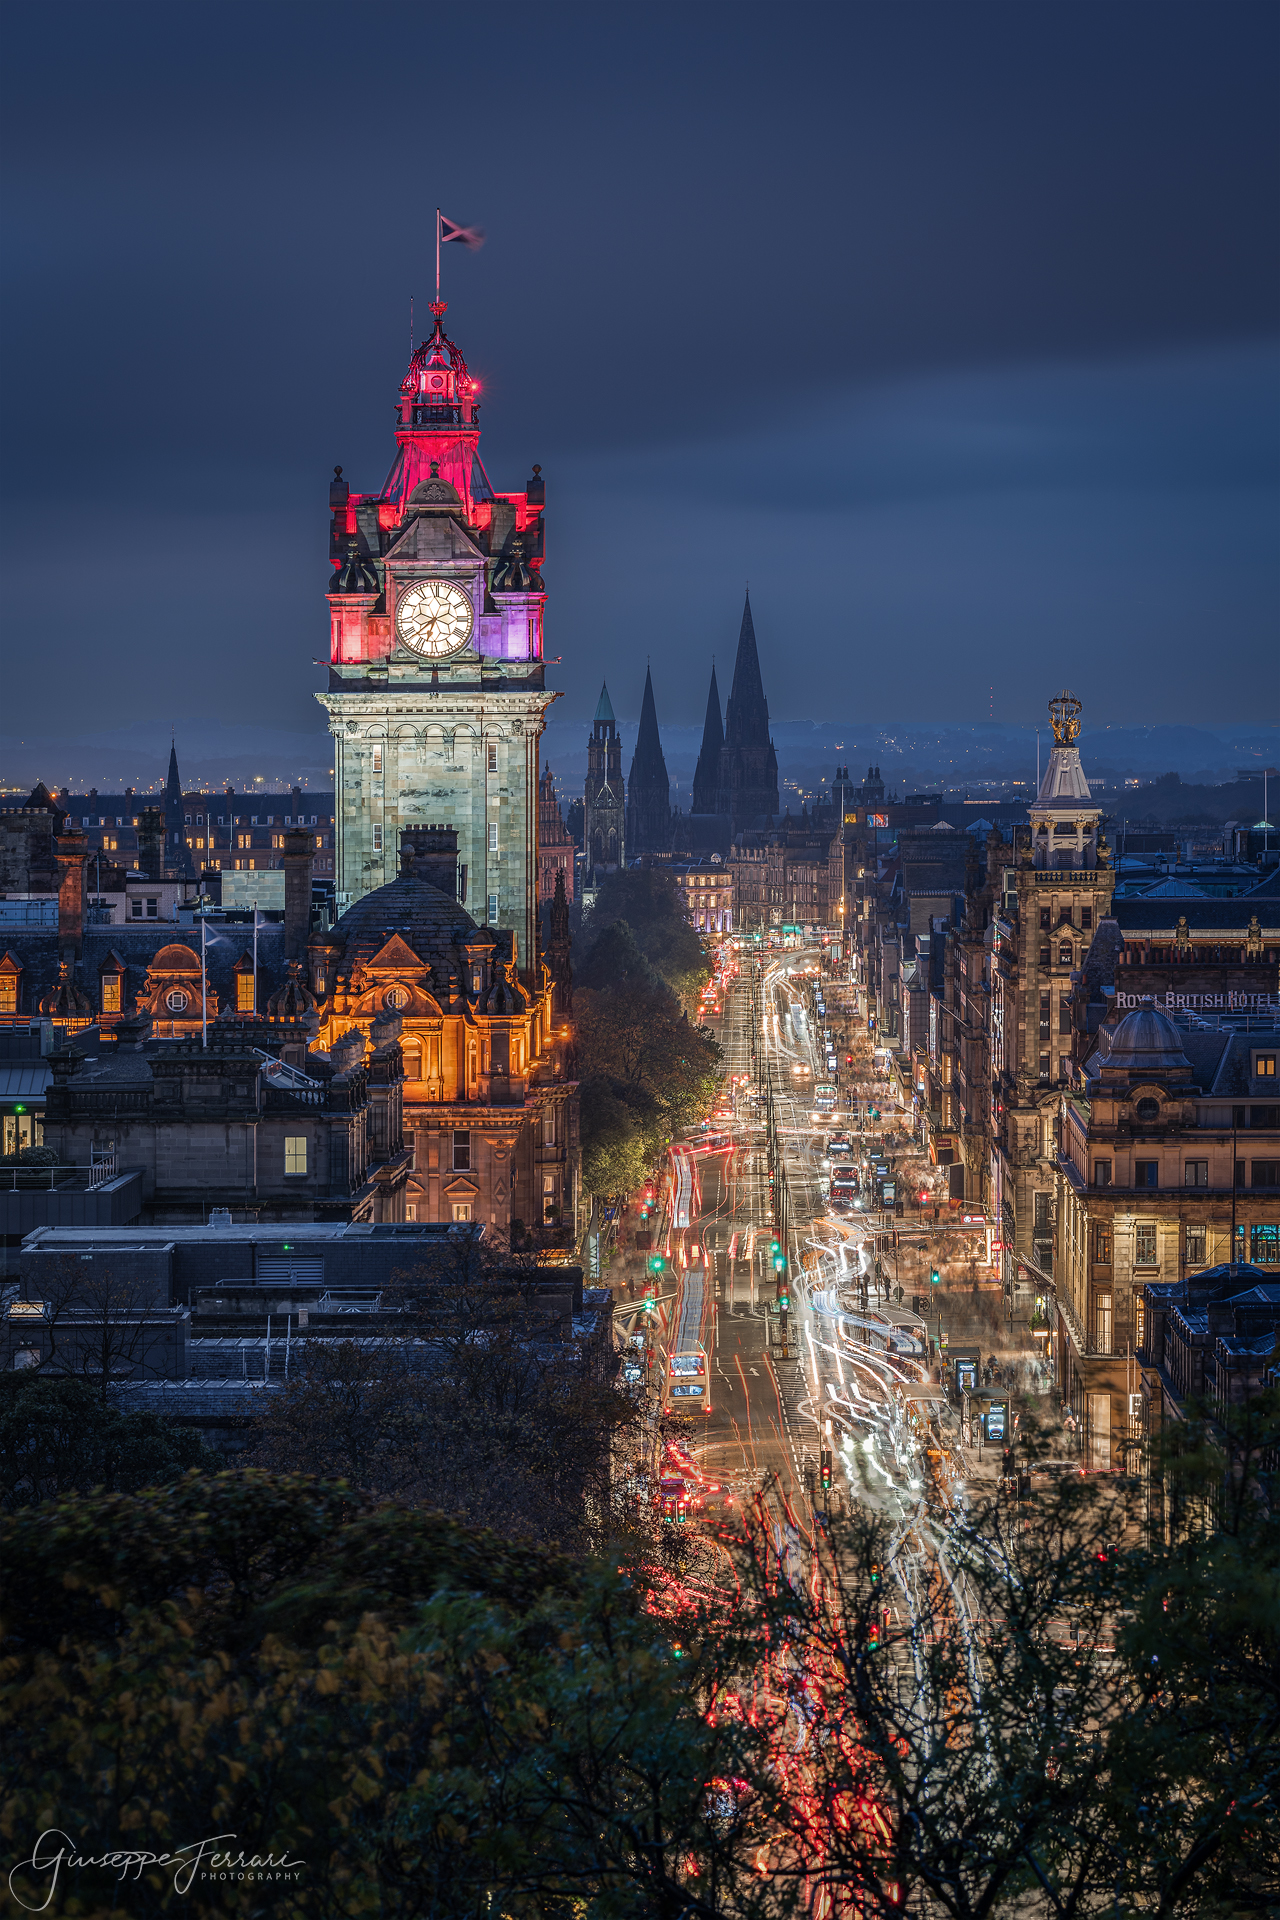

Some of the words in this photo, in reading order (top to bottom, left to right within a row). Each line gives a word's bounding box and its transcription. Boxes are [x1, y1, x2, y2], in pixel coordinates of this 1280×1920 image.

[1116, 991, 1162, 1008] ROYL
[1165, 991, 1224, 1008] BRITISH
[1228, 990, 1276, 1008] HOTEL
